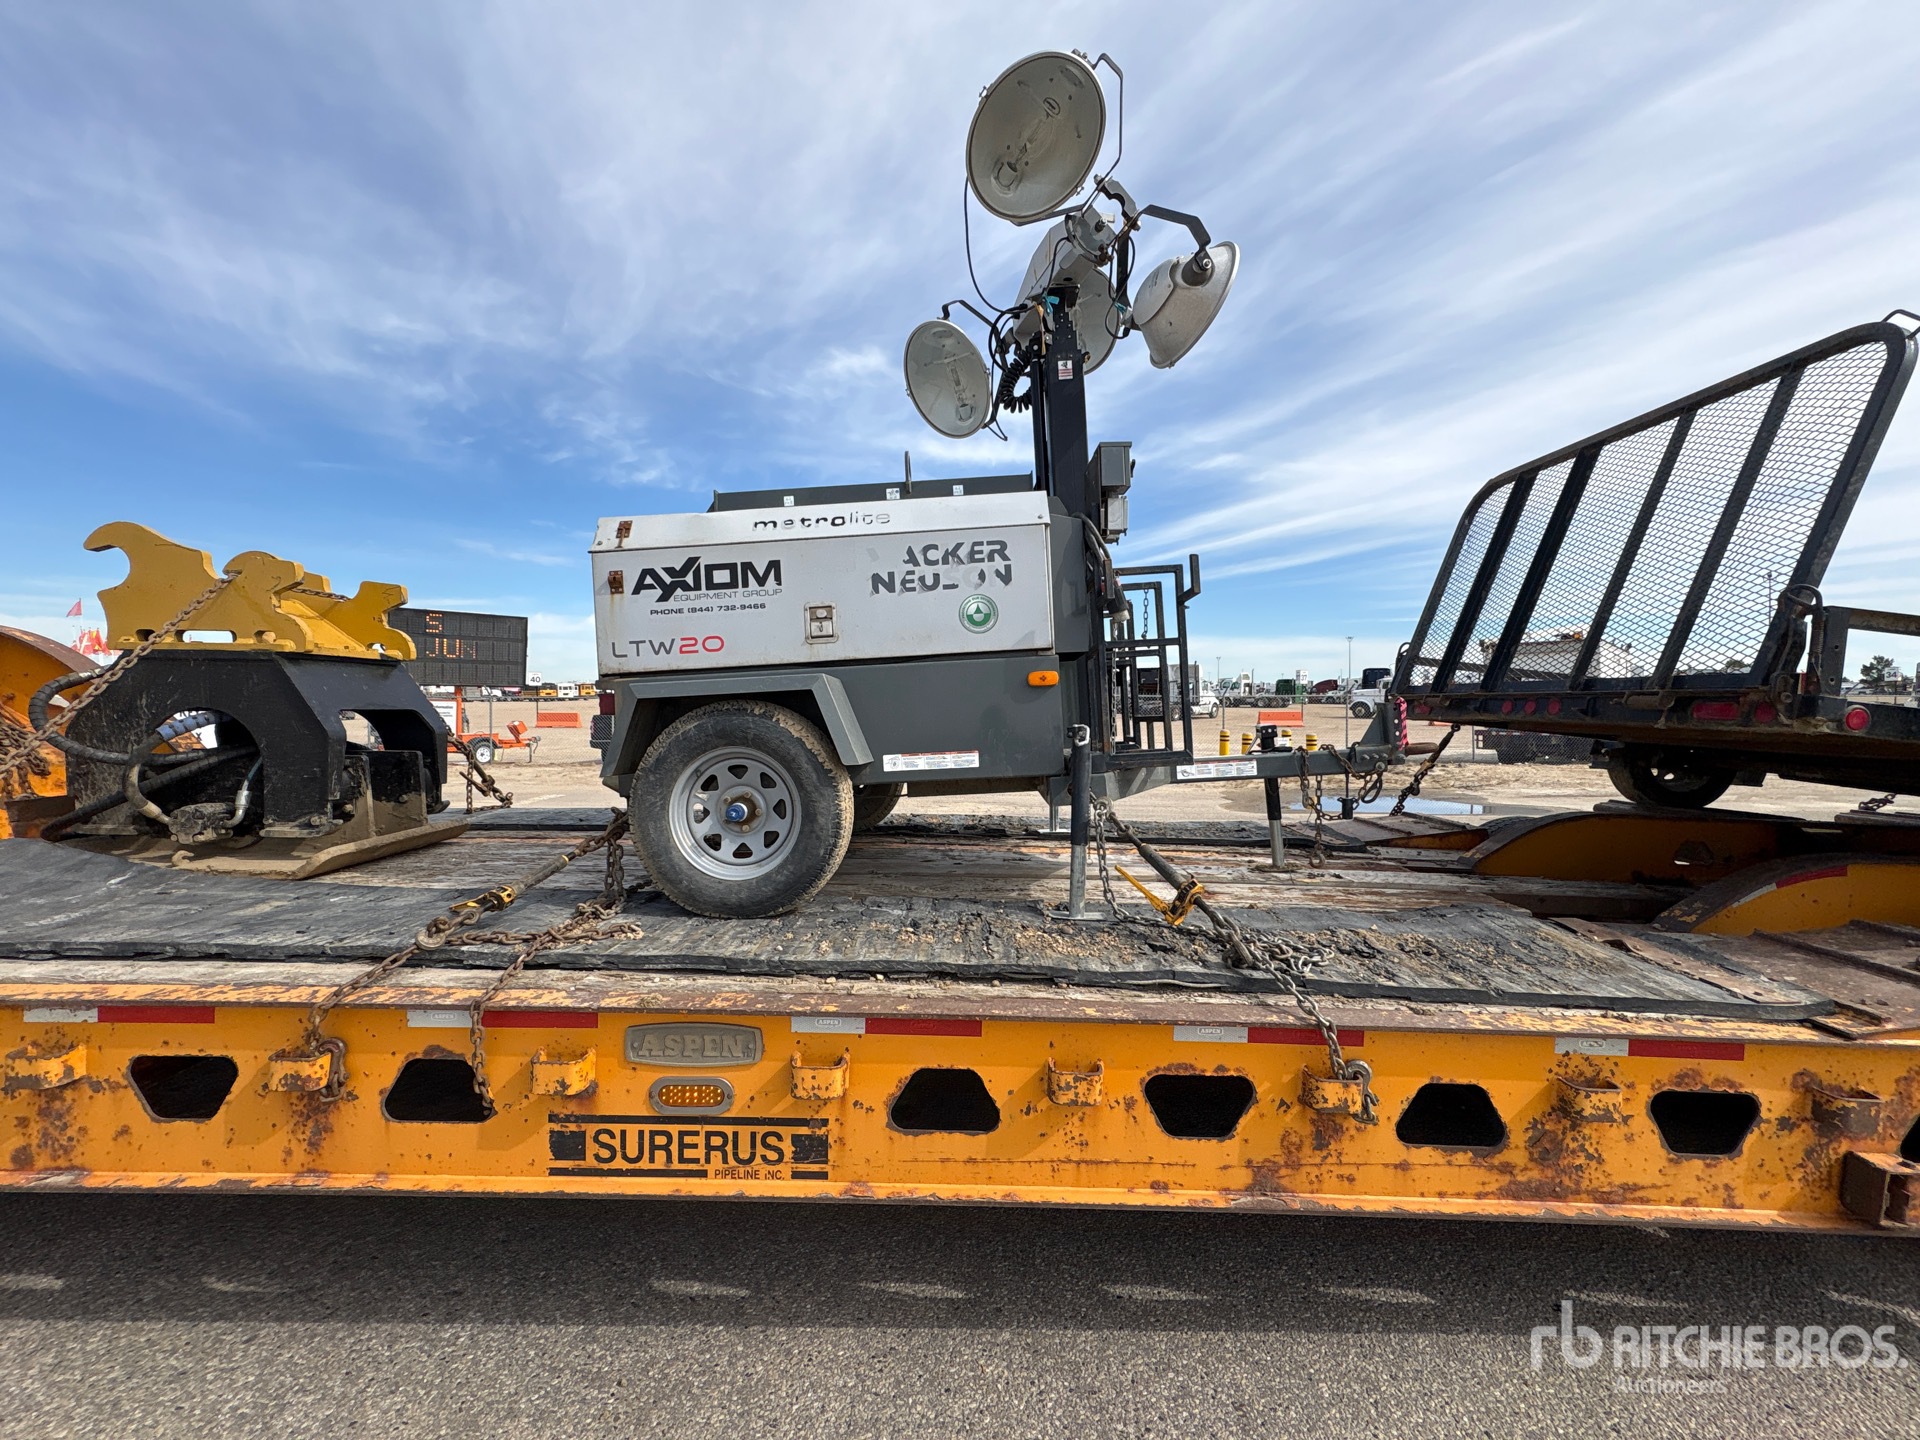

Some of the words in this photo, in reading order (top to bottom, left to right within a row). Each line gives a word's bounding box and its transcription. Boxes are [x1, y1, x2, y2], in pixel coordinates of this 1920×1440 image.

[752, 511, 890, 532] metrolite
[631, 556, 782, 602] AXIOM
[673, 591, 739, 602] EQUIPMENT
[742, 588, 783, 599] GROUP
[650, 608, 685, 616] PHONE
[687, 606, 714, 614] (844)
[716, 603, 766, 612] 732-9466
[611, 635, 725, 658] LTW20
[637, 1033, 745, 1058] ASPEN
[592, 1128, 785, 1166] SURERUS
[714, 1169, 761, 1180] PIPELINE
